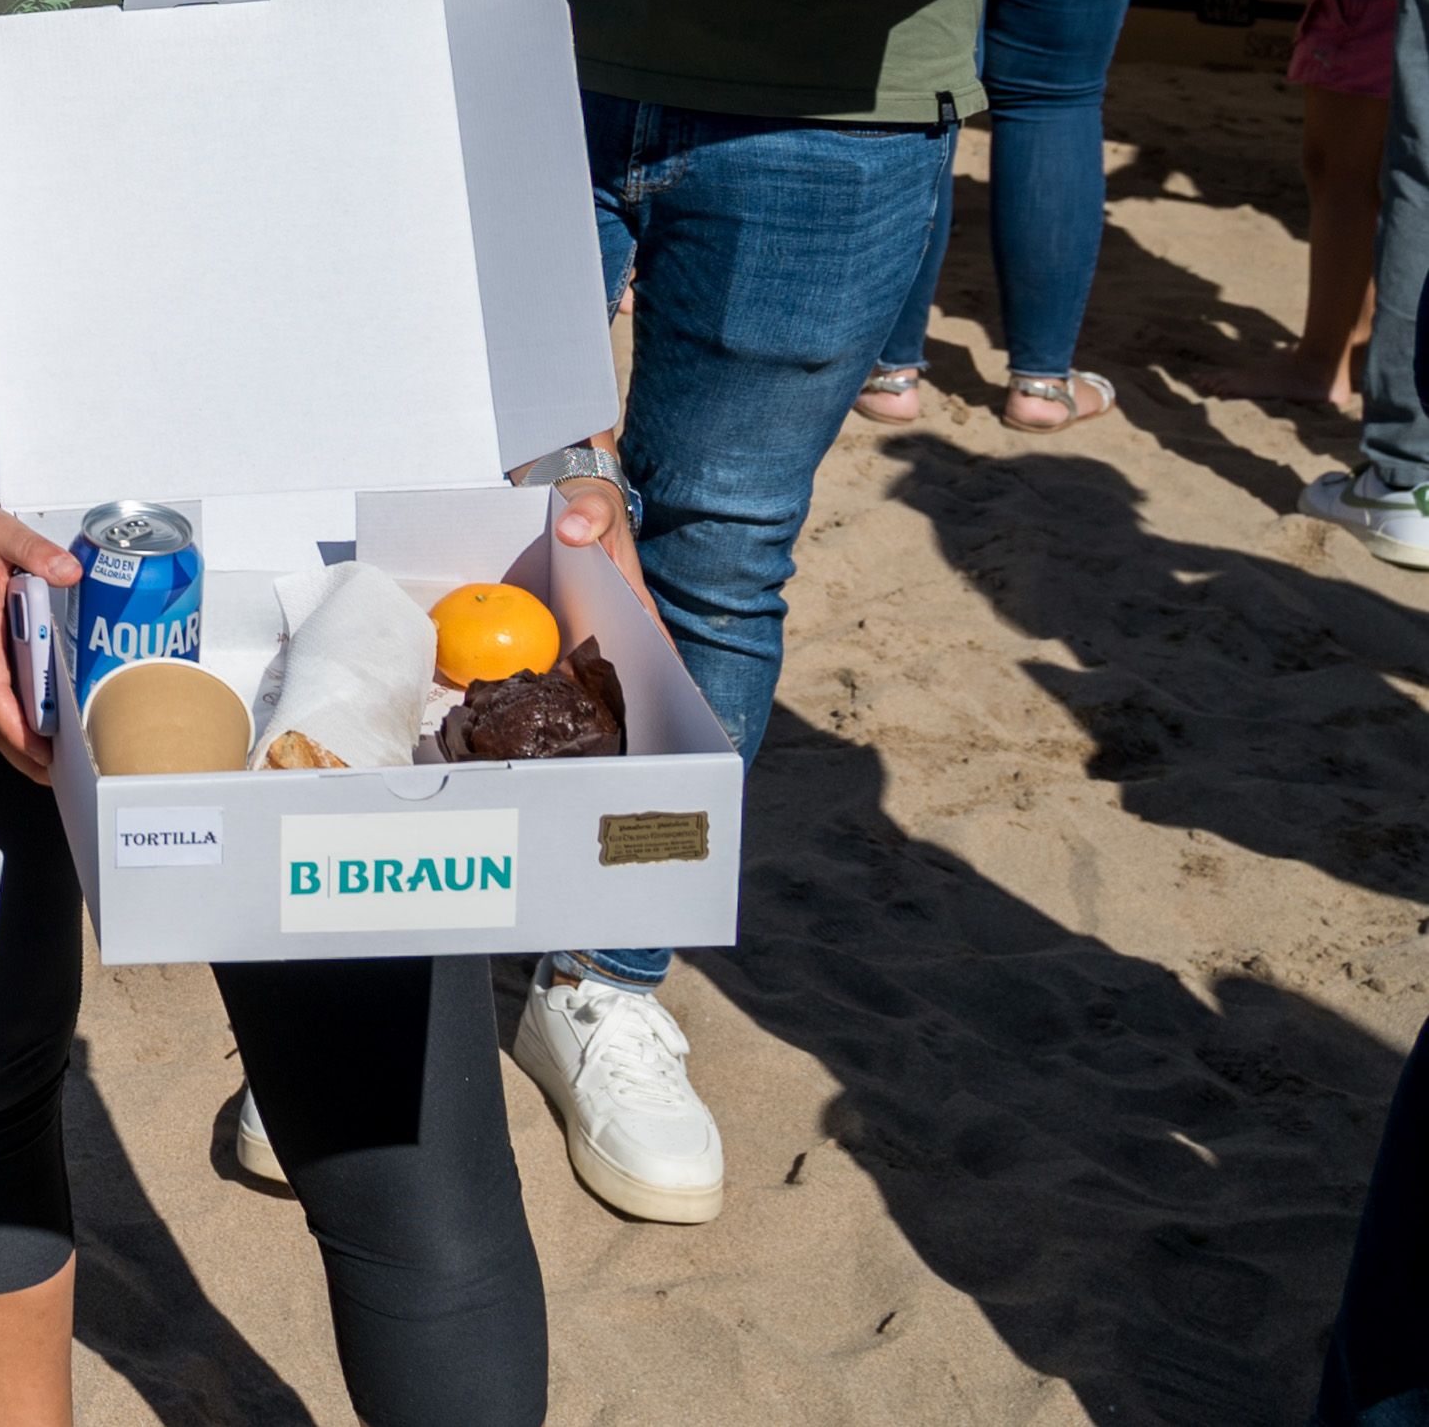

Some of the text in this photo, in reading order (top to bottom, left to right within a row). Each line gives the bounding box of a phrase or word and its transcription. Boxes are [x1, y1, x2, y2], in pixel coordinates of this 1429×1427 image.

[97, 553, 135, 571] BAJO EN
[120, 831, 218, 847] TORTILLA
[290, 856, 512, 895] B BRAUN
